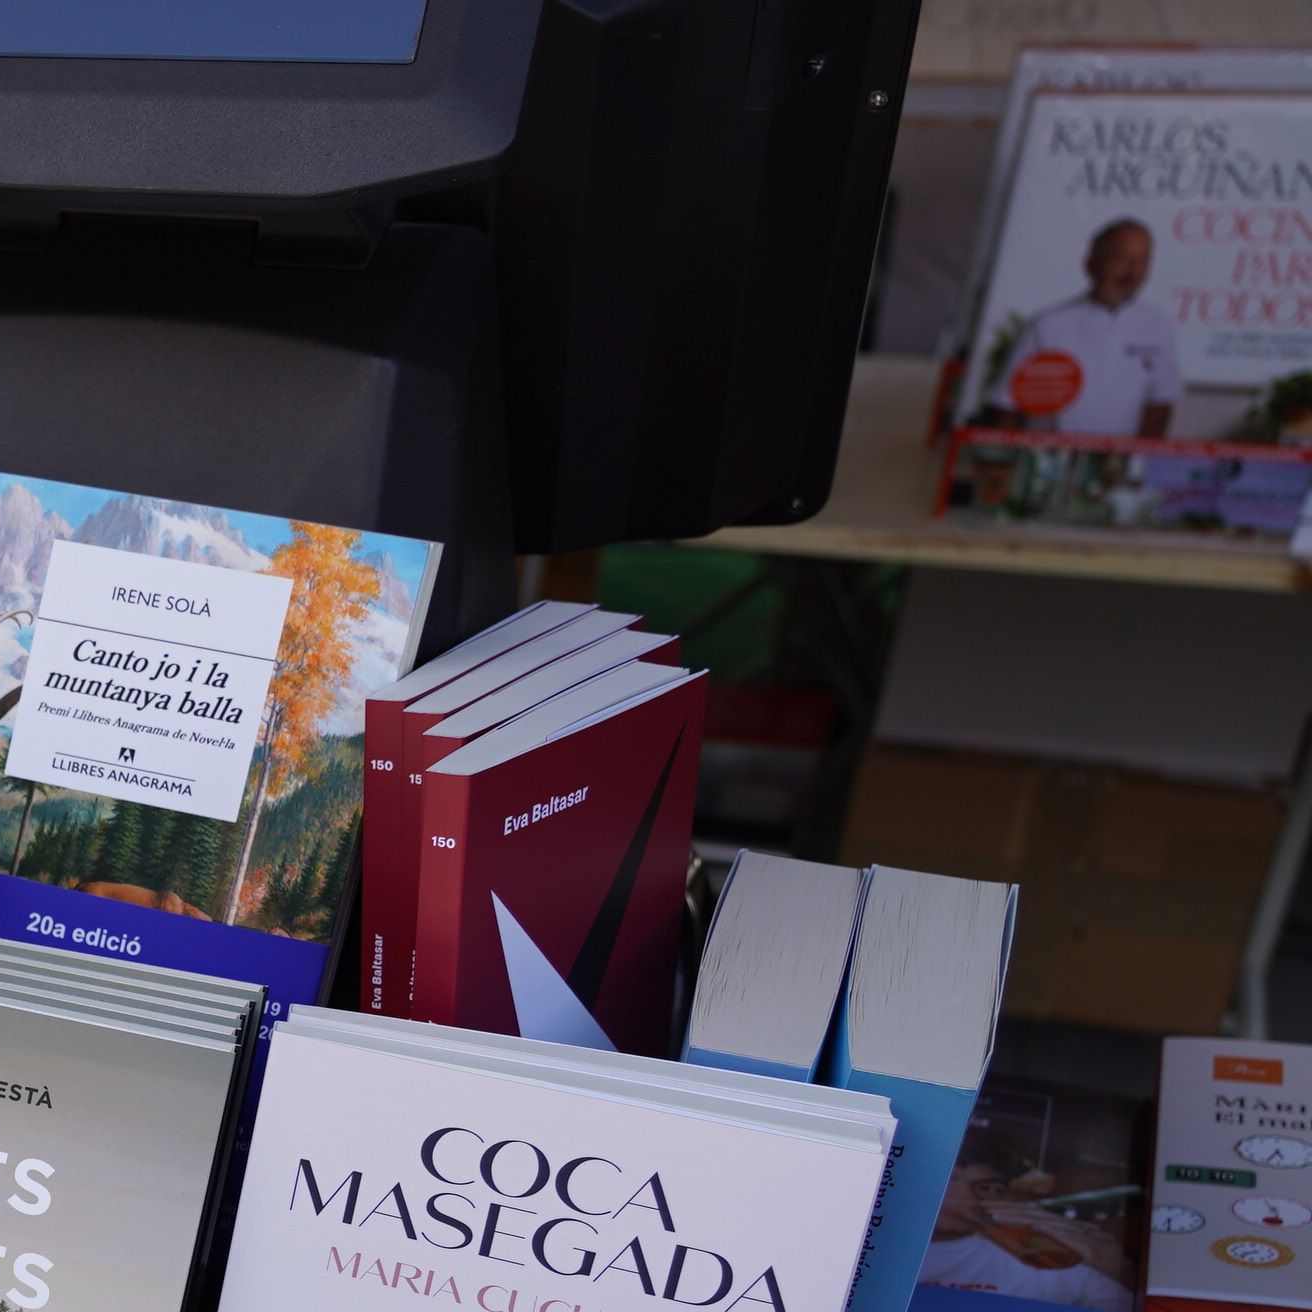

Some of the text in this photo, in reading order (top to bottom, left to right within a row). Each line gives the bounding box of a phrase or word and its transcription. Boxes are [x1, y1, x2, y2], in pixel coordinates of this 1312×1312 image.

[112, 586, 211, 617] IRENE SOLÀ
[73, 639, 229, 688] Canto jo i la
[43, 670, 243, 724] muntanya balla
[38, 702, 71, 717] Premi
[73, 708, 111, 726] Llibres
[113, 717, 169, 738] Anagrama
[172, 728, 187, 740] de
[52, 757, 193, 796] LLIBRES ANAGRAMA
[371, 759, 394, 772] 150
[503, 785, 589, 836] Eva Baltasar
[431, 836, 456, 849] 150
[26, 912, 65, 939] 20a
[72, 927, 142, 956] edició
[419, 1126, 677, 1234] COCA
[325, 1245, 463, 1306] MARIA
